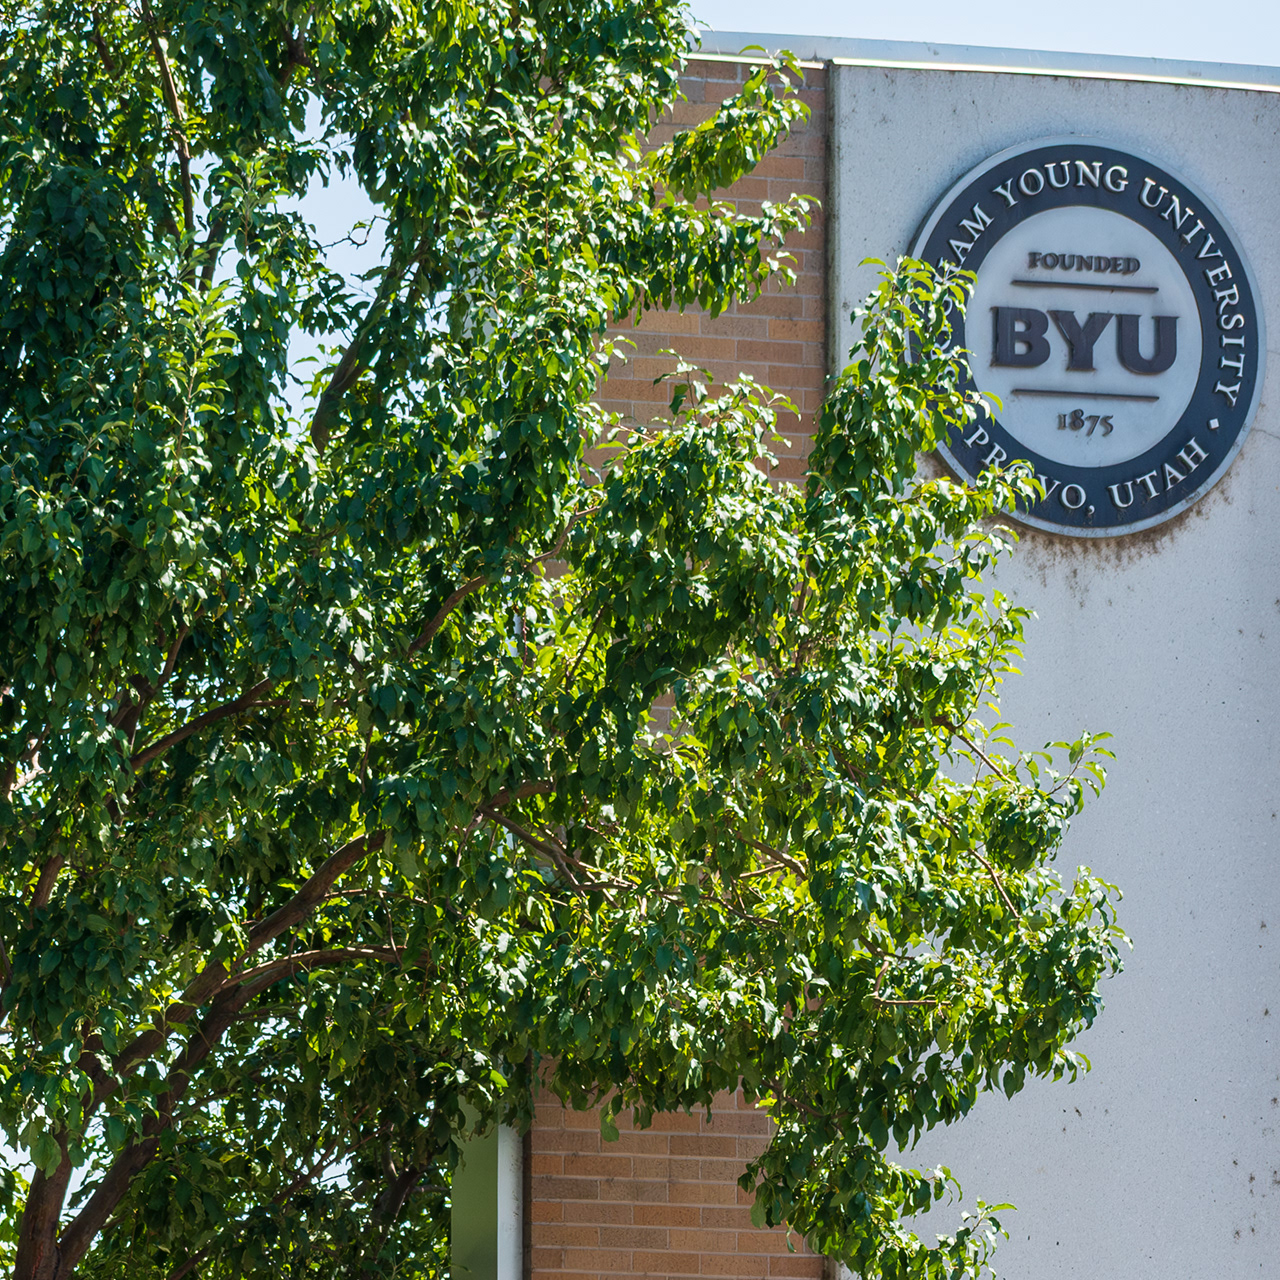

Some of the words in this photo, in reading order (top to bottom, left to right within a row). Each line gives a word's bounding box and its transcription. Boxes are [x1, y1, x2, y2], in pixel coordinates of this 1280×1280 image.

[929, 202, 995, 389] BRHAM
[991, 160, 1129, 208] YOUNG
[1138, 176, 1246, 408] UNIVERSITY
[1028, 251, 1141, 275] FOUNDED
[990, 306, 1179, 376] BYU
[1057, 408, 1114, 437] 1875
[1107, 437, 1210, 509] UTAH
